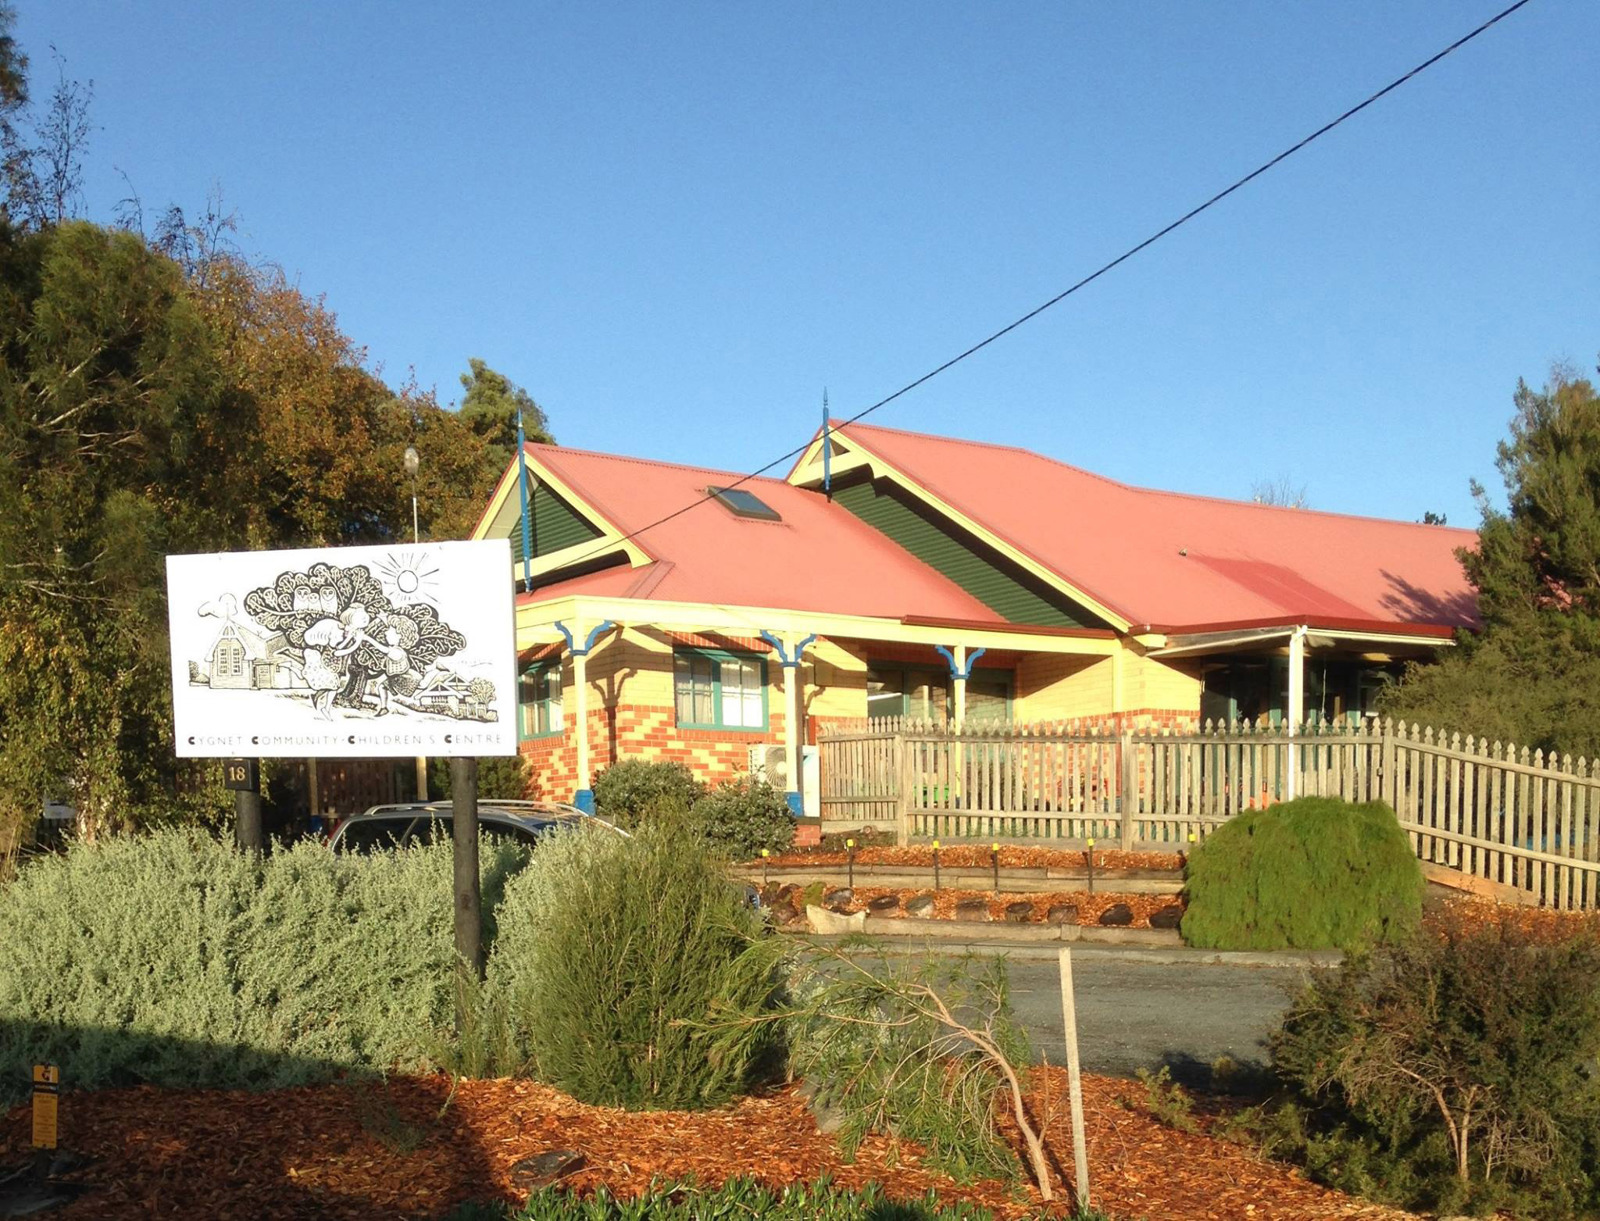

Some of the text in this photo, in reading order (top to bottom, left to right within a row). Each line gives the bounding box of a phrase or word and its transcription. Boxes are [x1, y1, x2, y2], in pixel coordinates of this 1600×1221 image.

[187, 735, 243, 746] CYGNET
[251, 735, 338, 746] COMMUNITY
[444, 733, 501, 745] CENTRE
[228, 766, 246, 781] 18
